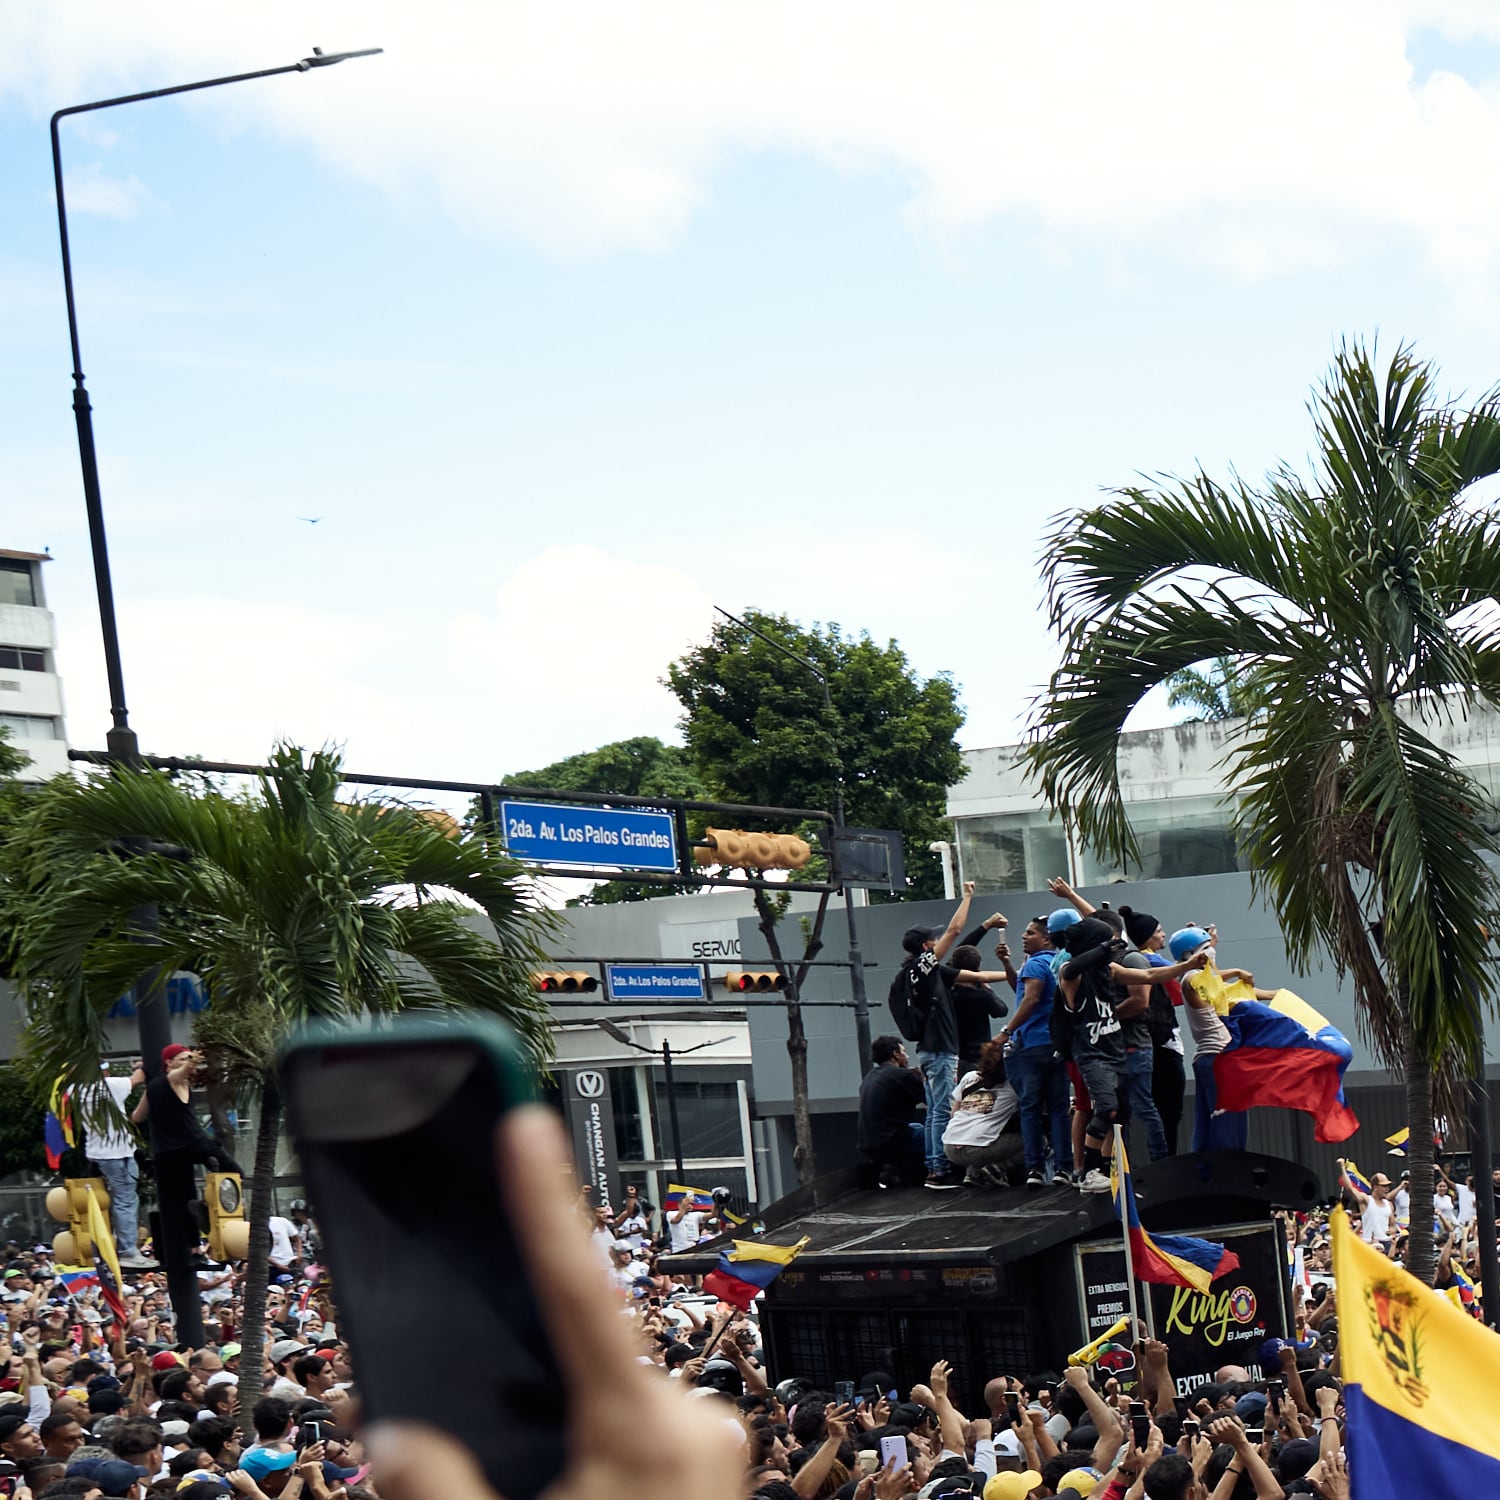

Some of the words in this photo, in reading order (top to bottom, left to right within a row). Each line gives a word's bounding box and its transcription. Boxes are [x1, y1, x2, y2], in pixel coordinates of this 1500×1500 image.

[510, 818, 536, 839] 2da.
[539, 821, 558, 841] Av.
[560, 823, 584, 843] Los
[585, 825, 619, 845] Palos
[621, 828, 670, 849] Grandes
[638, 976, 651, 986] Los
[652, 976, 671, 987] Palos
[672, 976, 699, 987] Grandes
[1166, 1286, 1231, 1347] King
